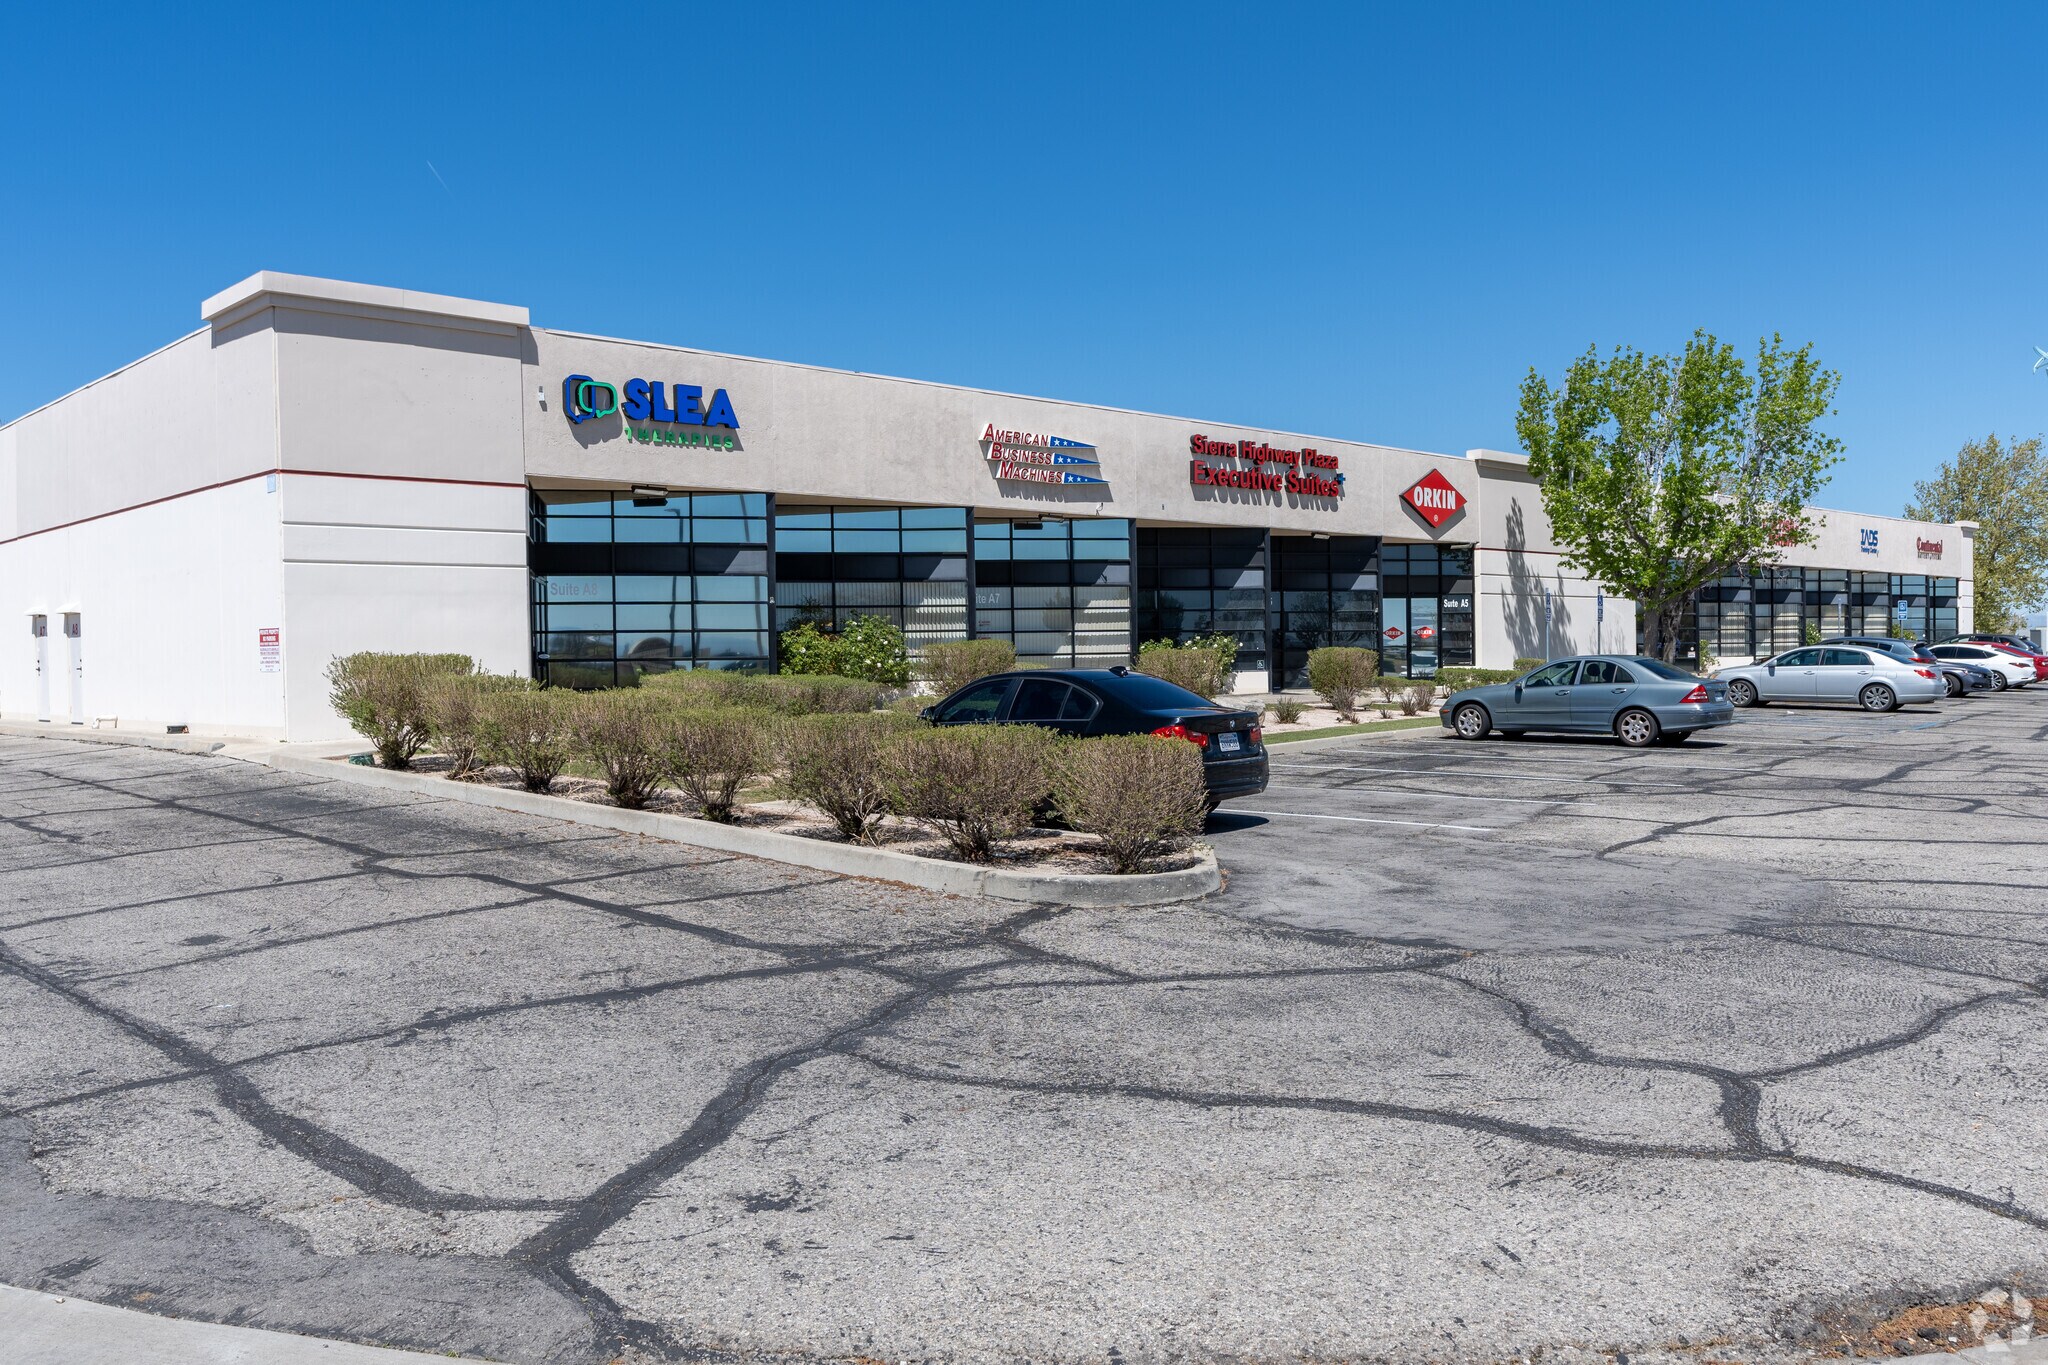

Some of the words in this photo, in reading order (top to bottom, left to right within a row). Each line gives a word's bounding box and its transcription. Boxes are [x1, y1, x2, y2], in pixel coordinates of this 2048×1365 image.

[622, 378, 740, 429] SLEA
[624, 427, 734, 448] THERAPIES
[982, 423, 1049, 447] AMERICAN
[989, 442, 1053, 465] BUSINESS
[1190, 434, 1237, 457] Sierra
[1238, 440, 1300, 468] Highway
[1302, 448, 1338, 469] Plaza
[998, 461, 1063, 484] MACHINES
[1190, 460, 1283, 491] Executive
[1285, 470, 1339, 497] Suites
[1413, 486, 1456, 510] ORKIN
[550, 583, 579, 596] Suite
[583, 583, 598, 595] A8
[976, 593, 987, 604] ite
[988, 593, 1000, 604] A7
[1443, 599, 1458, 608] Suite
[1460, 599, 1469, 608] A5
